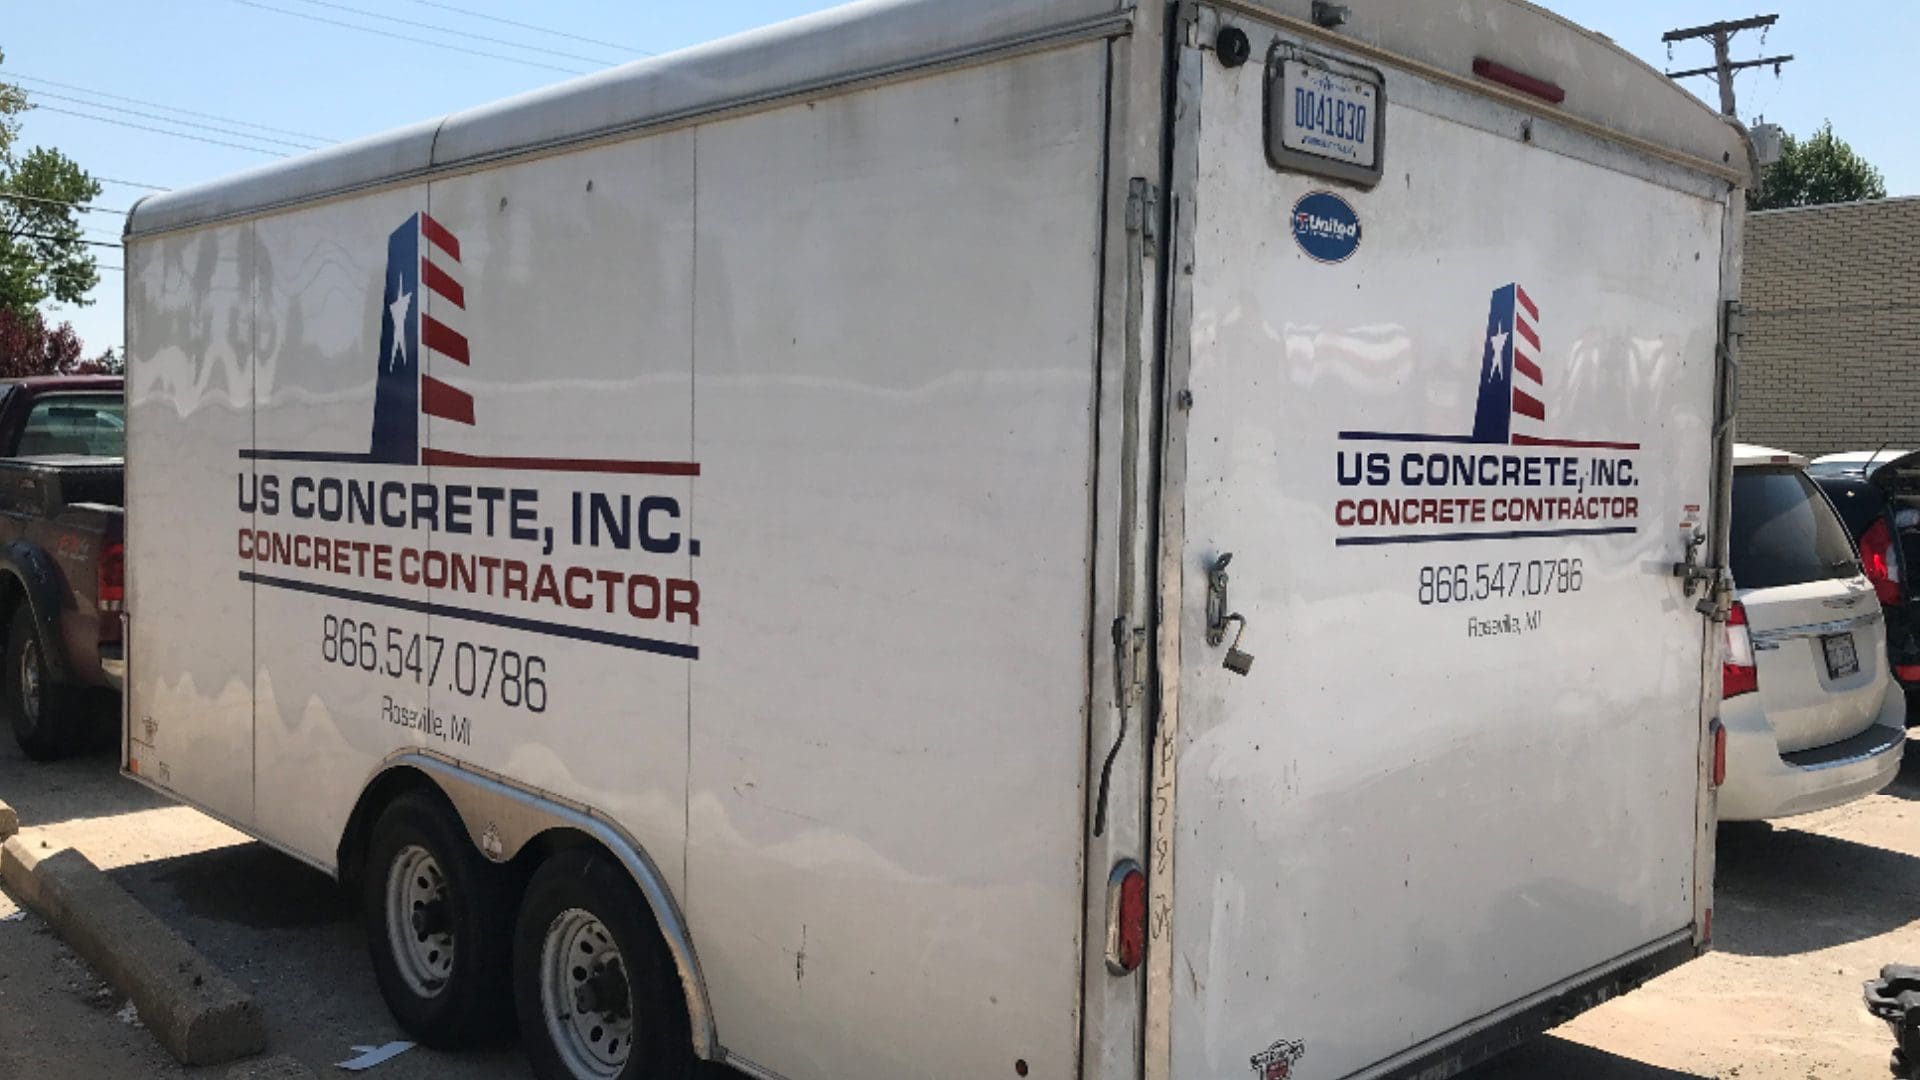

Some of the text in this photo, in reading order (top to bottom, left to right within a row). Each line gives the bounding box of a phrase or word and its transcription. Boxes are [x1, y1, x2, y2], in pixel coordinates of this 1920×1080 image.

[1295, 87, 1366, 144] D041830
[1309, 214, 1357, 238] United
[1336, 451, 1639, 494] US CONCRETE, INC.
[238, 472, 701, 557] US CONCRETE, INC.
[1334, 496, 1639, 526] CONCRETE CONTRACTOR
[238, 527, 701, 626] CONCRETE CONTRACTOR
[1418, 557, 1583, 605] 866.547.0786
[321, 613, 548, 714] 866.547.0786
[381, 694, 471, 747] Roseville, MI
